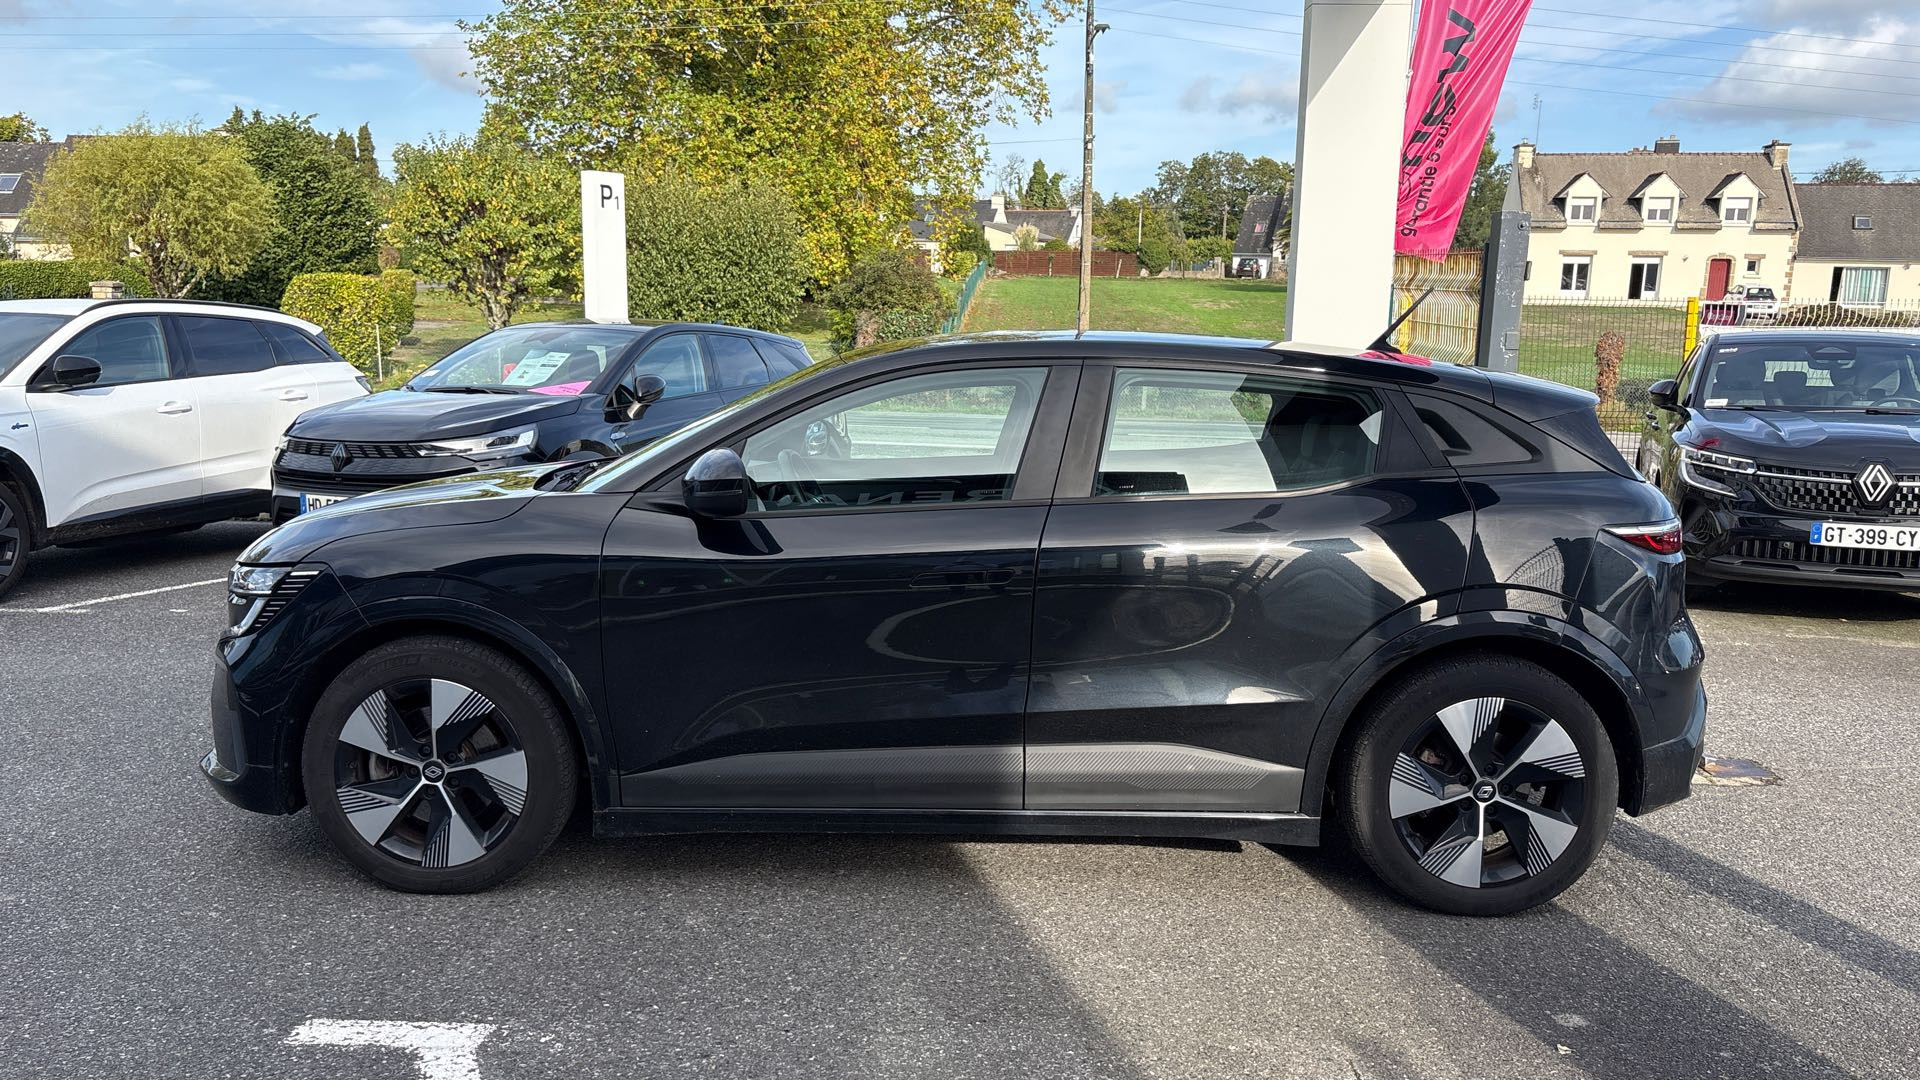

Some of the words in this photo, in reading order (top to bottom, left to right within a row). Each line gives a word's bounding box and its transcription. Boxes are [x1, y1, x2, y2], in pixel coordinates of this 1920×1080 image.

[1400, 166, 1438, 237] garantie
[1427, 151, 1441, 163] 5
[1434, 118, 1453, 149] sur
[1824, 526, 1918, 547] GT-399-CY
